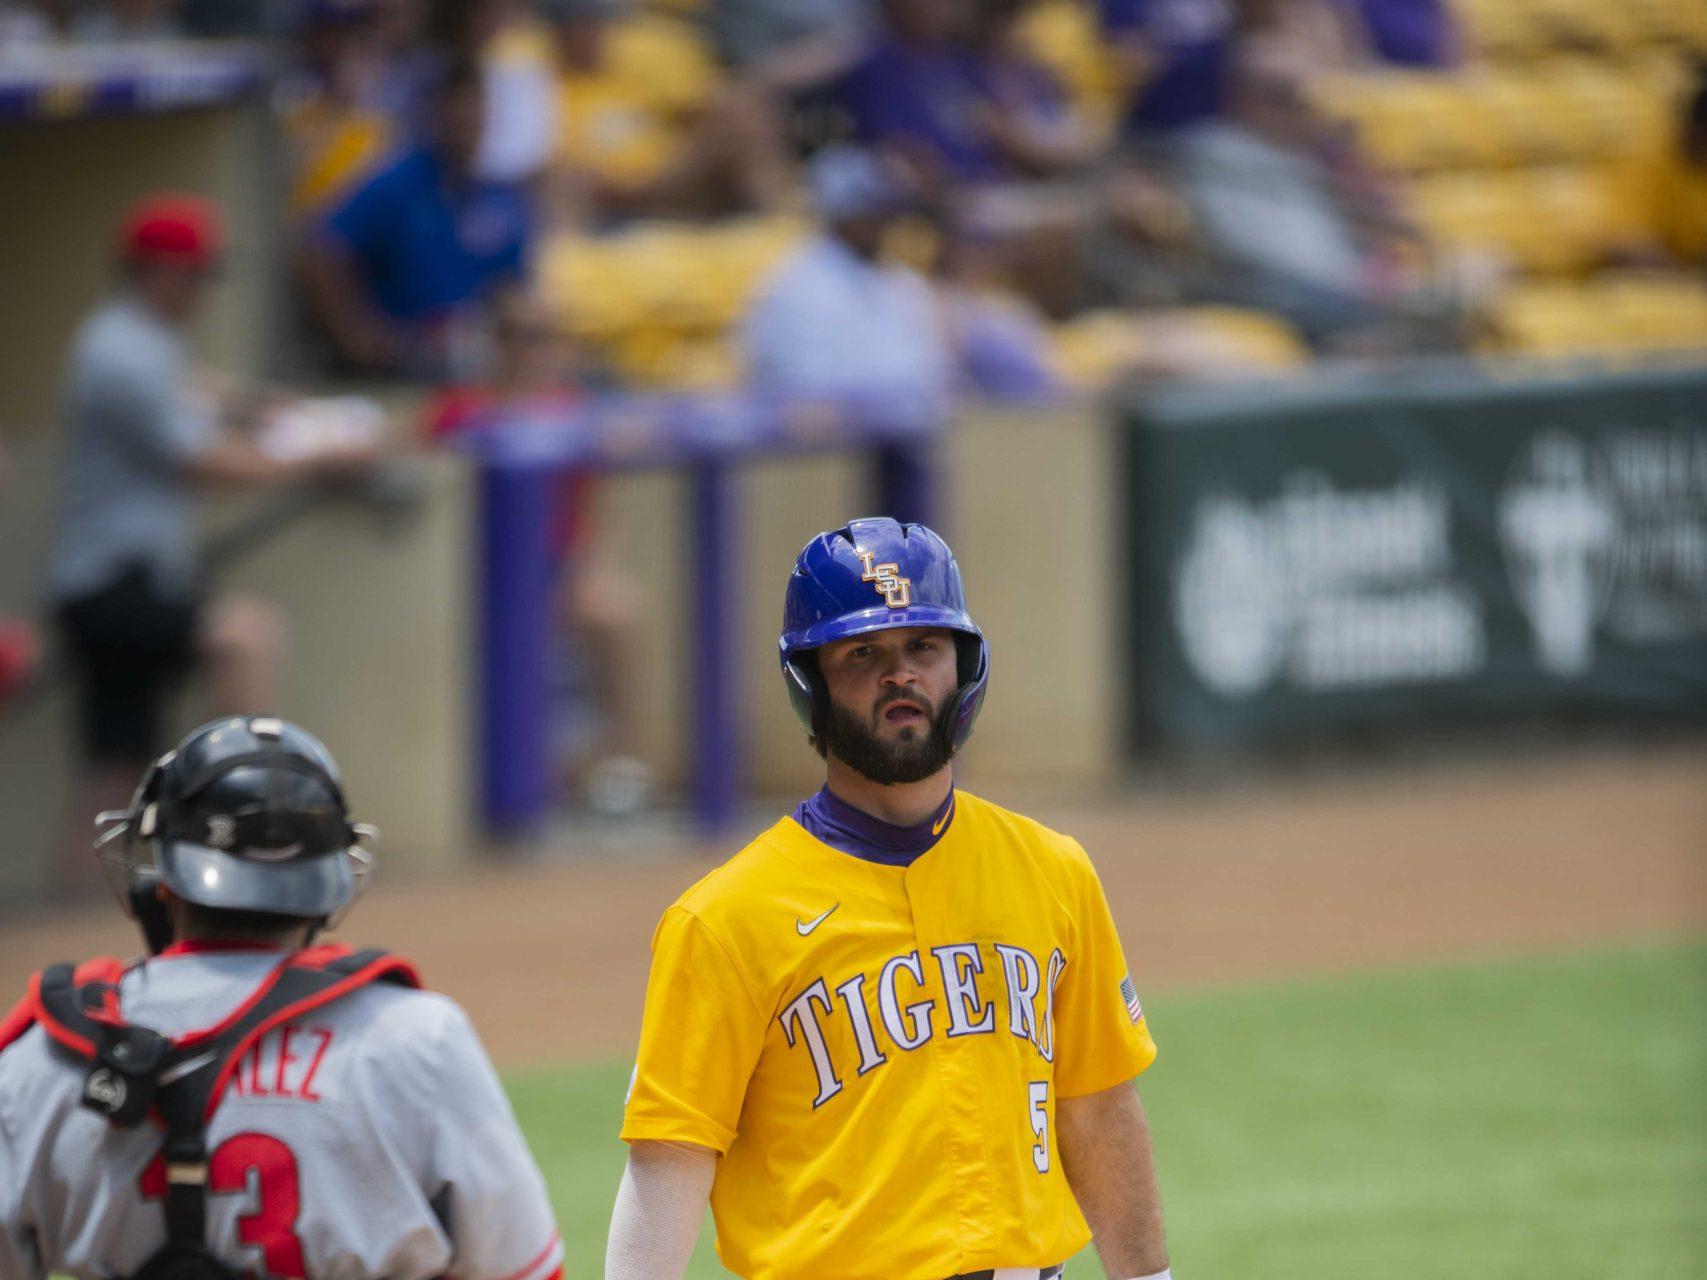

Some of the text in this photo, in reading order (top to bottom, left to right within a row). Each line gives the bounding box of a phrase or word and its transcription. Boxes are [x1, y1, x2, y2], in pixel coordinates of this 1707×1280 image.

[859, 552, 911, 609] LSU
[231, 1025, 334, 1103] LEZ
[777, 943, 1067, 1111] TIGERS
[1028, 1080, 1049, 1175] 5
